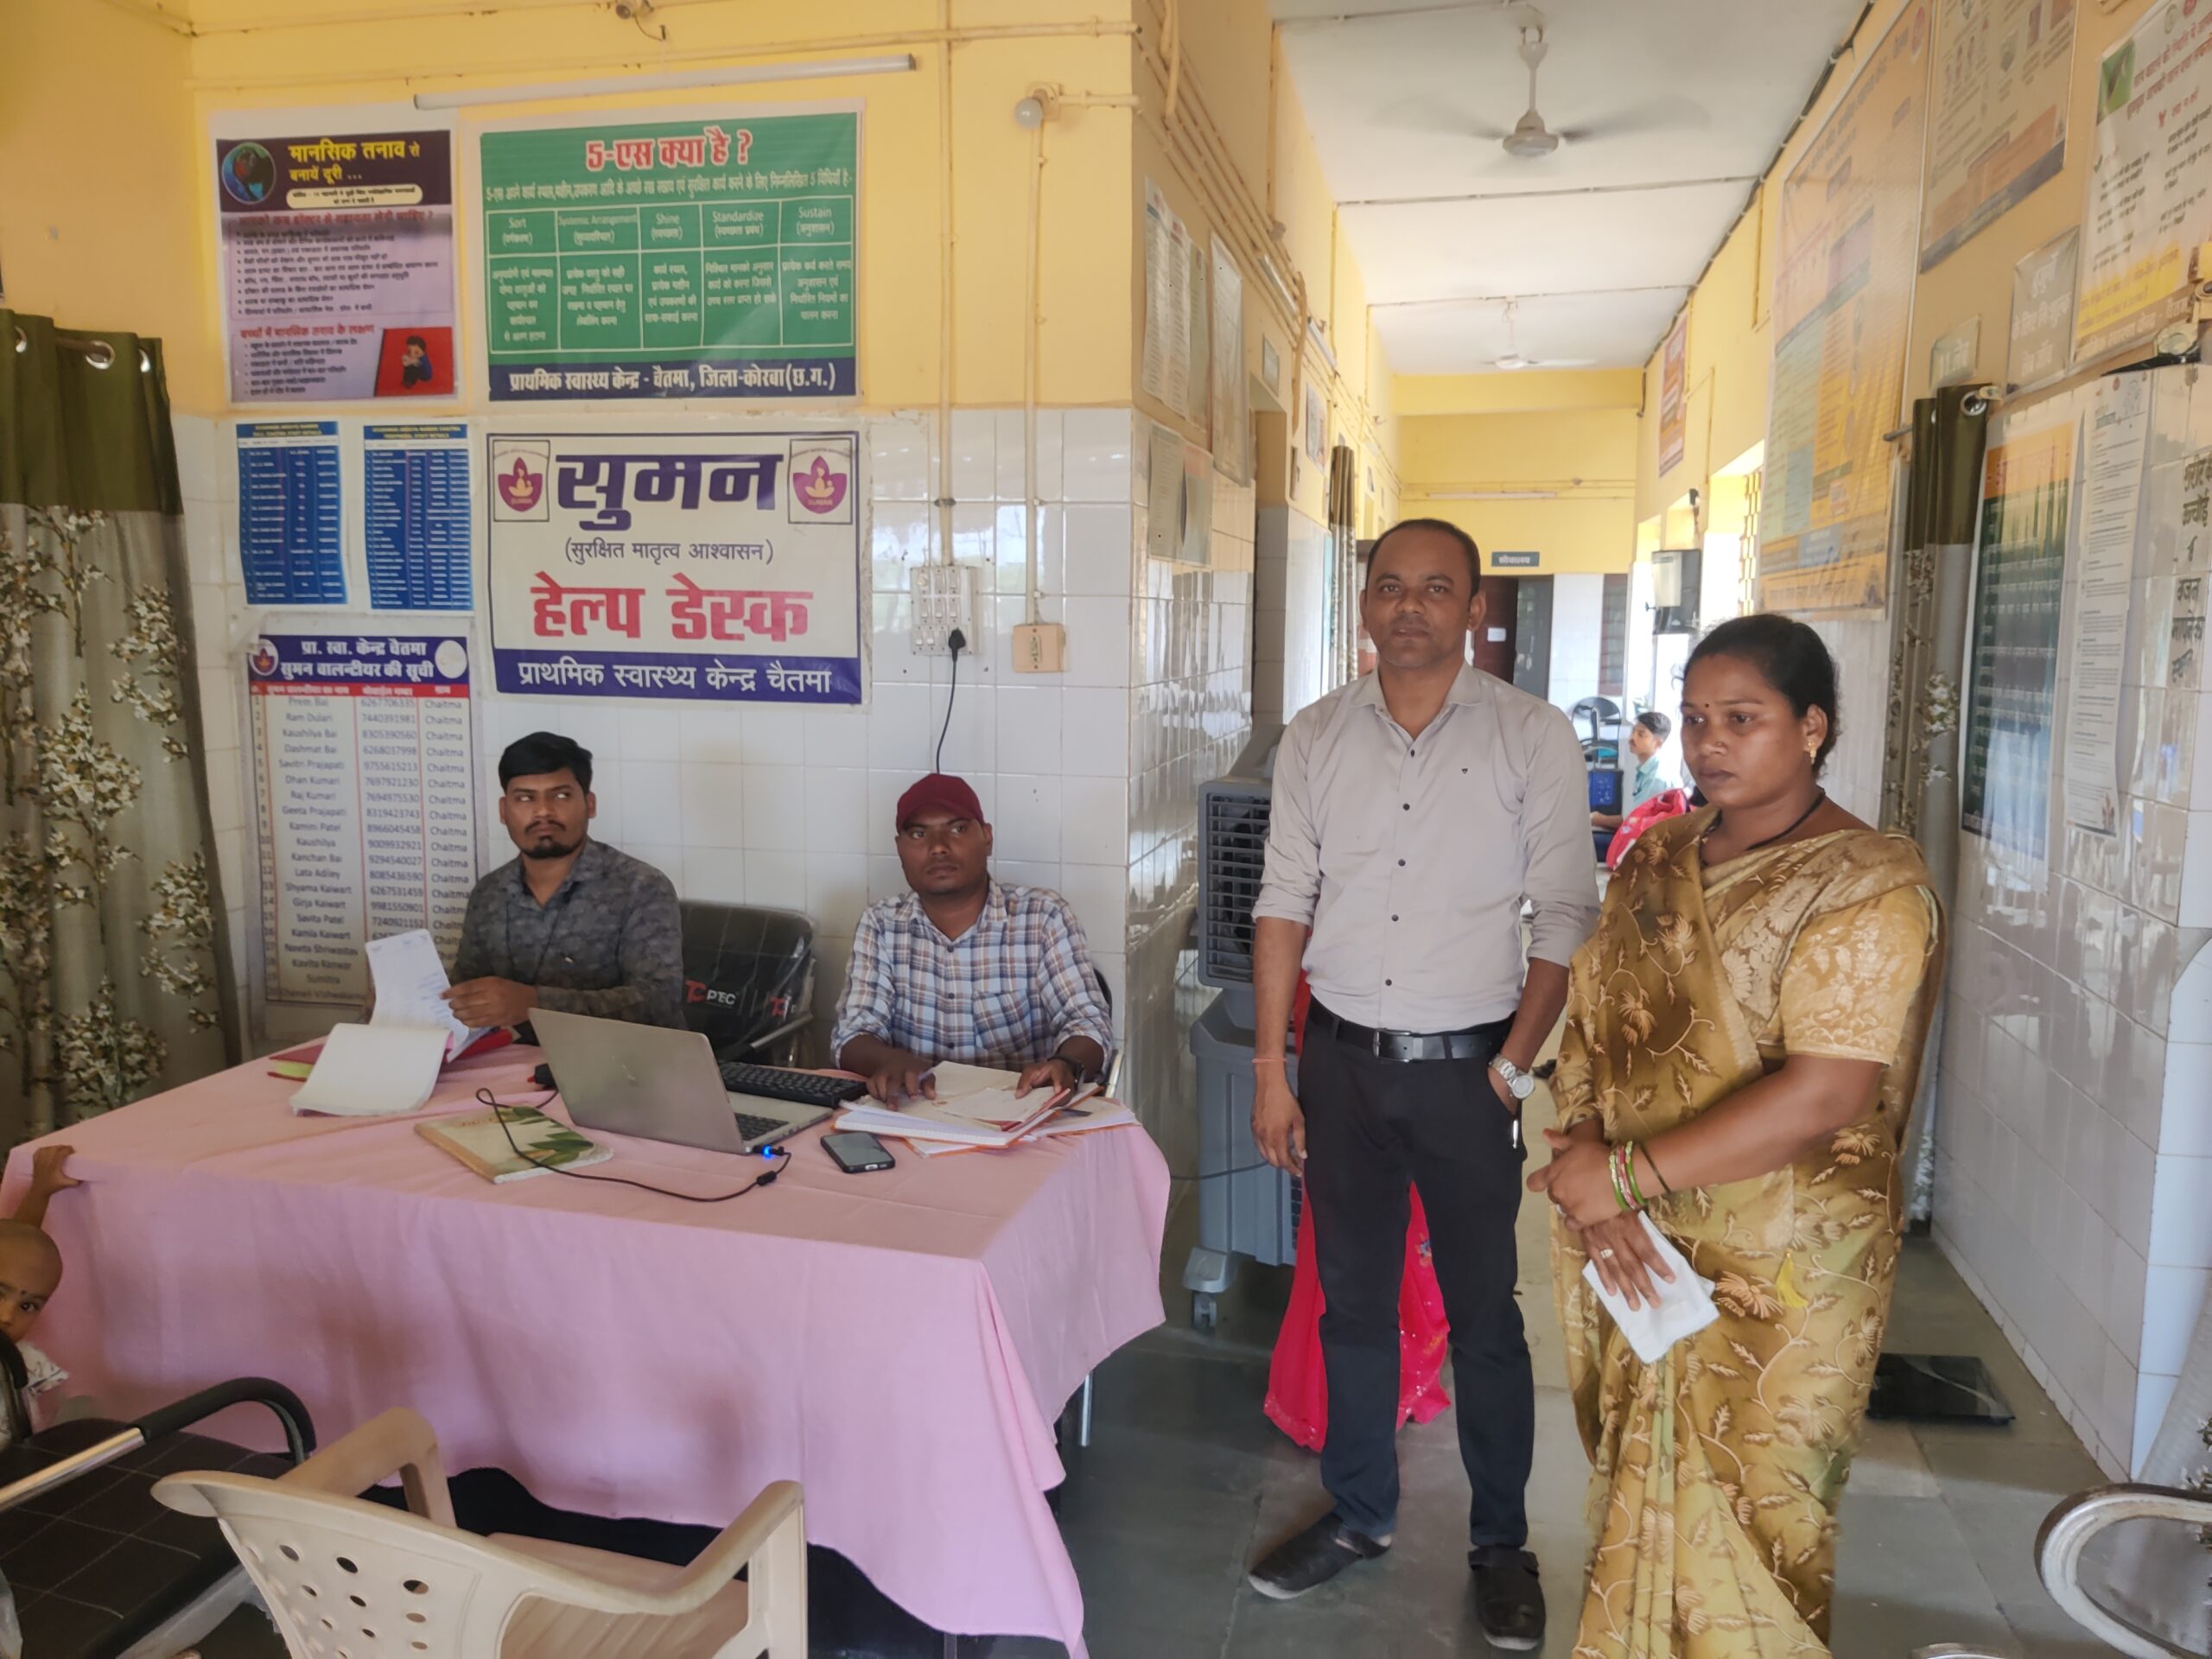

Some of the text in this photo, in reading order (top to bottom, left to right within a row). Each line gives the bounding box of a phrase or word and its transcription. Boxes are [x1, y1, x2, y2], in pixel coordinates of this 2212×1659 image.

[288, 137, 357, 163] मानसिक
[360, 140, 405, 159] तनाव
[586, 127, 753, 170] 5-एस क्या है ?
[322, 162, 342, 184] दूरी
[712, 211, 765, 223] Standardize
[798, 207, 832, 219] Sustain
[656, 213, 680, 226] Shine
[510, 367, 562, 391] प्राथमिक
[565, 372, 609, 391] स्वास्थ्य
[612, 365, 640, 391] केन्द्र
[556, 454, 784, 531] सुमन
[564, 537, 773, 566] (सुरक्षित मातृत्व आश्वासन)
[530, 570, 814, 642] हेल्प डेस्क
[301, 641, 322, 655] प्रा.
[327, 641, 353, 655] स्वा.
[356, 638, 386, 656] केन्द्र
[280, 662, 314, 680] सुमन
[384, 659, 403, 677] की
[405, 660, 435, 683] सूची
[518, 655, 832, 693] प्राथमिक स्वास्थ्य केन्द्र चैतमा
[425, 700, 462, 709] Chaitma
[425, 715, 463, 725] Chaitma
[426, 731, 463, 741] Chaitma
[427, 747, 464, 757] Chaitma
[427, 762, 465, 773] Chaitma
[428, 779, 466, 789] Chaitma
[429, 795, 467, 805] Chaitma
[429, 810, 467, 820] Chaitma
[430, 826, 467, 837] Chaitma
[431, 842, 468, 852] Chaitma
[431, 857, 469, 868] Chaitma
[431, 873, 470, 884] Chaitma
[432, 888, 472, 899] Chaitma
[432, 905, 467, 915] Chaitm
[433, 919, 464, 931] Chaitm
